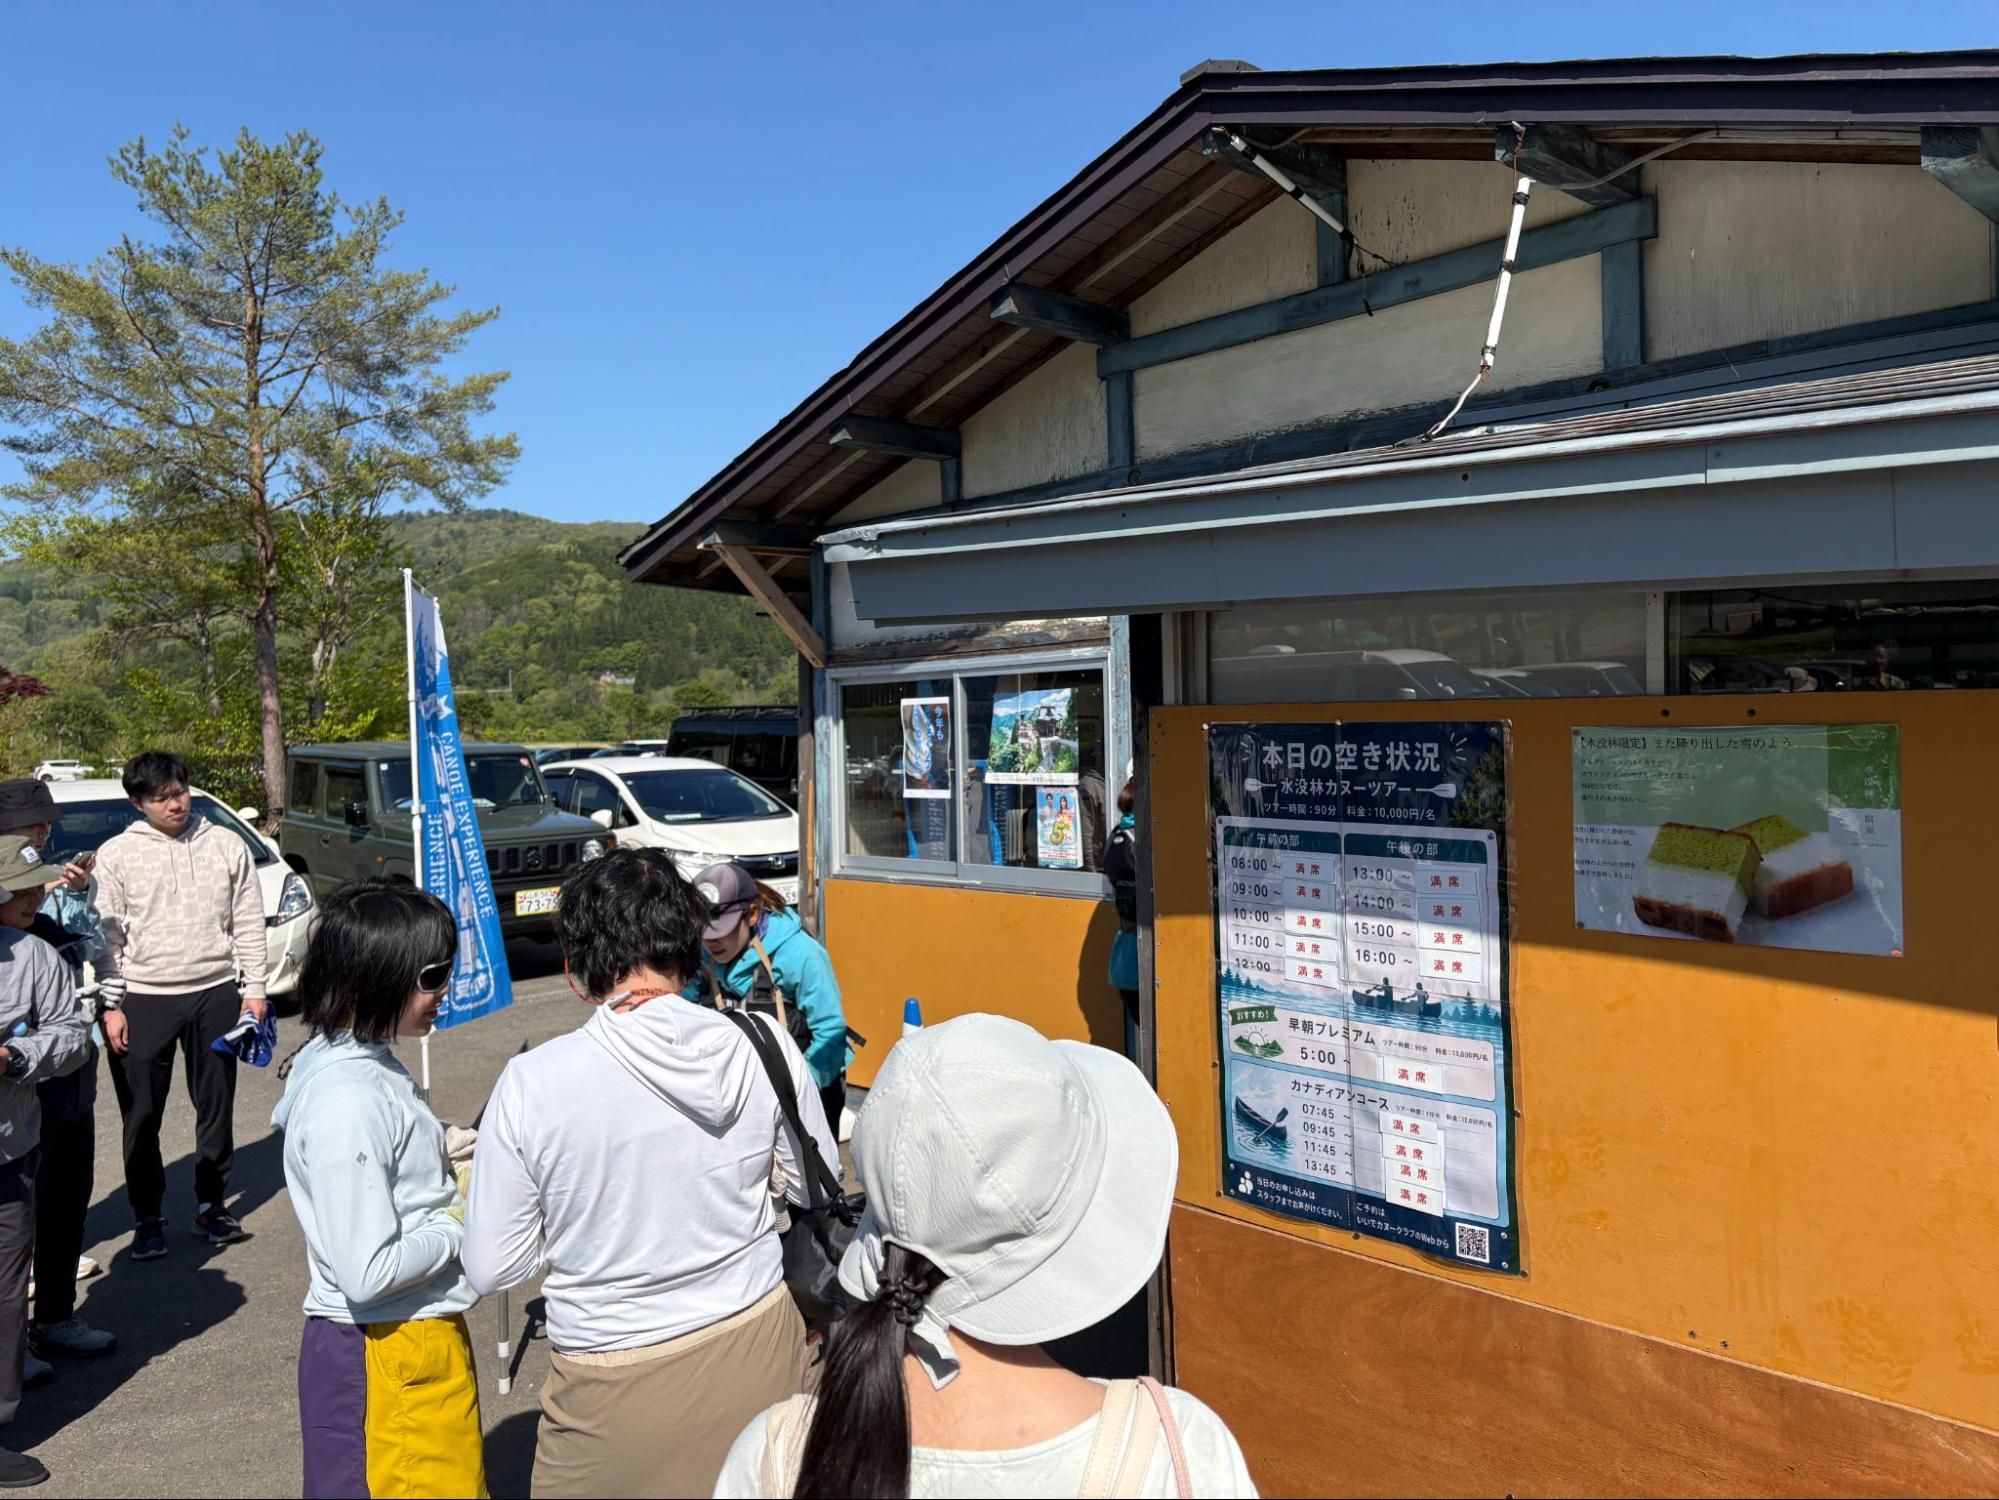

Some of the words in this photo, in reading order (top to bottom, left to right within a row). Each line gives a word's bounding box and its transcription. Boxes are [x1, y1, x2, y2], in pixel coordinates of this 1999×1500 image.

[1262, 740, 1441, 772] 本日の空き状況
[1280, 778, 1411, 797] 水没林カヌーツアー
[1264, 803, 1337, 816] ツアー時間：90分
[1346, 806, 1436, 821] 料金：10,000円/名
[441, 731, 464, 794] CANOE
[455, 799, 495, 918] EXPERIENCE
[1256, 832, 1300, 847] 午前の部
[1386, 840, 1439, 857] 午後の部
[1231, 857, 1267, 871] 08:00
[1295, 863, 1320, 875] 満席
[1353, 866, 1393, 882] 13:00
[1430, 875, 1459, 888] 満席
[1232, 882, 1268, 897] 09:00
[1296, 885, 1321, 899] 満席
[1234, 907, 1269, 923] 10:00
[1297, 915, 1321, 929] 満席
[1354, 894, 1394, 910] 14:00
[1433, 905, 1463, 918] 満席
[1235, 933, 1269, 949] 11:00
[1296, 941, 1320, 954] 満席
[1354, 922, 1394, 938] 15:00
[1434, 932, 1463, 945] 満席
[1235, 958, 1271, 972] 12:00
[1298, 966, 1323, 979] 満席
[1355, 949, 1396, 965] 16:00
[1434, 959, 1463, 973] 満席
[1236, 1009, 1269, 1020] おすすめ！
[1289, 1017, 1375, 1045] 早朝プレミアム
[1300, 1047, 1336, 1065] 5:00
[1398, 1068, 1426, 1083] 満席
[1291, 1079, 1389, 1110] カナディアンコース
[1302, 1103, 1334, 1119] 07:45
[1393, 1119, 1420, 1135] 満席
[1303, 1122, 1335, 1138] 09:45
[1396, 1144, 1424, 1160] 満席
[1304, 1140, 1336, 1156] 11:45
[1400, 1164, 1428, 1180] 満席
[1256, 1176, 1316, 1200] 当日のお申し込みは
[1305, 1159, 1336, 1175] 13:45
[1400, 1188, 1427, 1205] 満席
[1257, 1189, 1343, 1220] スタッフまでお声がけください。
[1356, 1201, 1386, 1217] ご予約は
[1356, 1216, 1450, 1249] いいでカヌークラブのWebから
